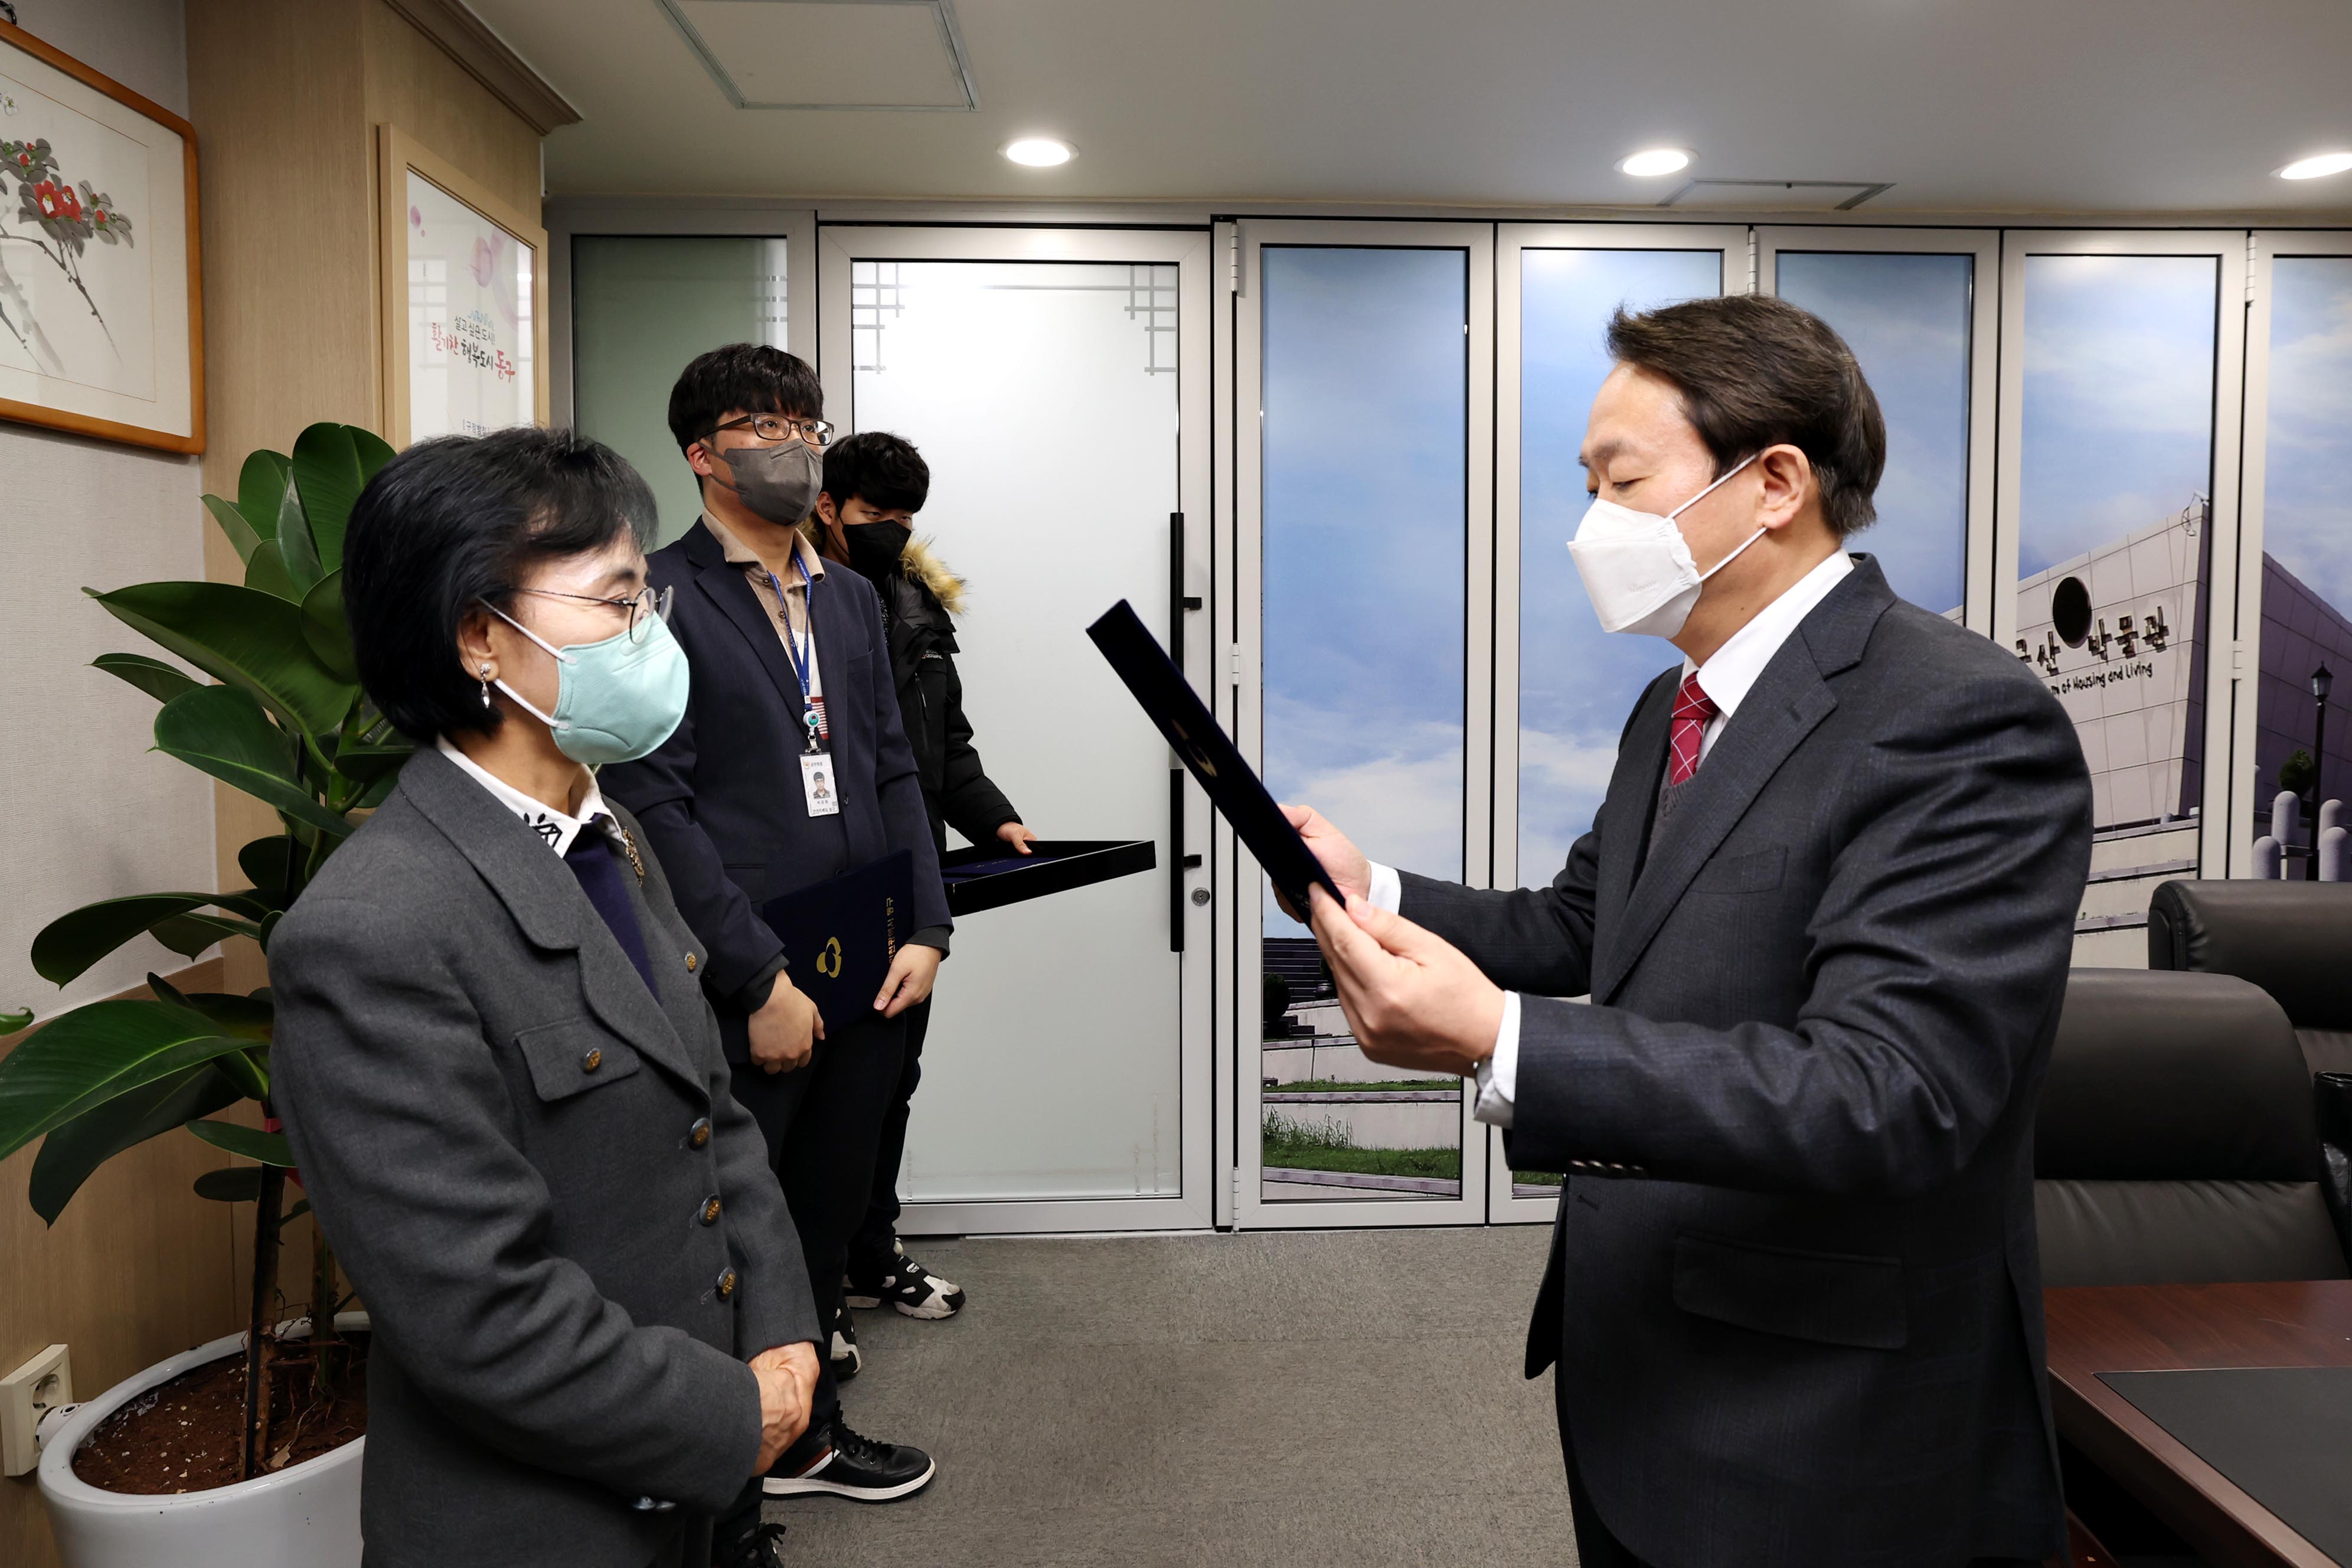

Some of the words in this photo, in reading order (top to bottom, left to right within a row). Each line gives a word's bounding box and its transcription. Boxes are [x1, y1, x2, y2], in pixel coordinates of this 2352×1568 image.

[431, 322, 459, 355] 활기찬
[460, 338, 494, 370] 행복도시
[494, 349, 515, 383] 동구
[2088, 606, 2170, 661] 박물관
[2062, 678, 2071, 694] of
[2073, 672, 2106, 689] Housing
[2108, 665, 2124, 683] and
[2125, 661, 2154, 678] Living
